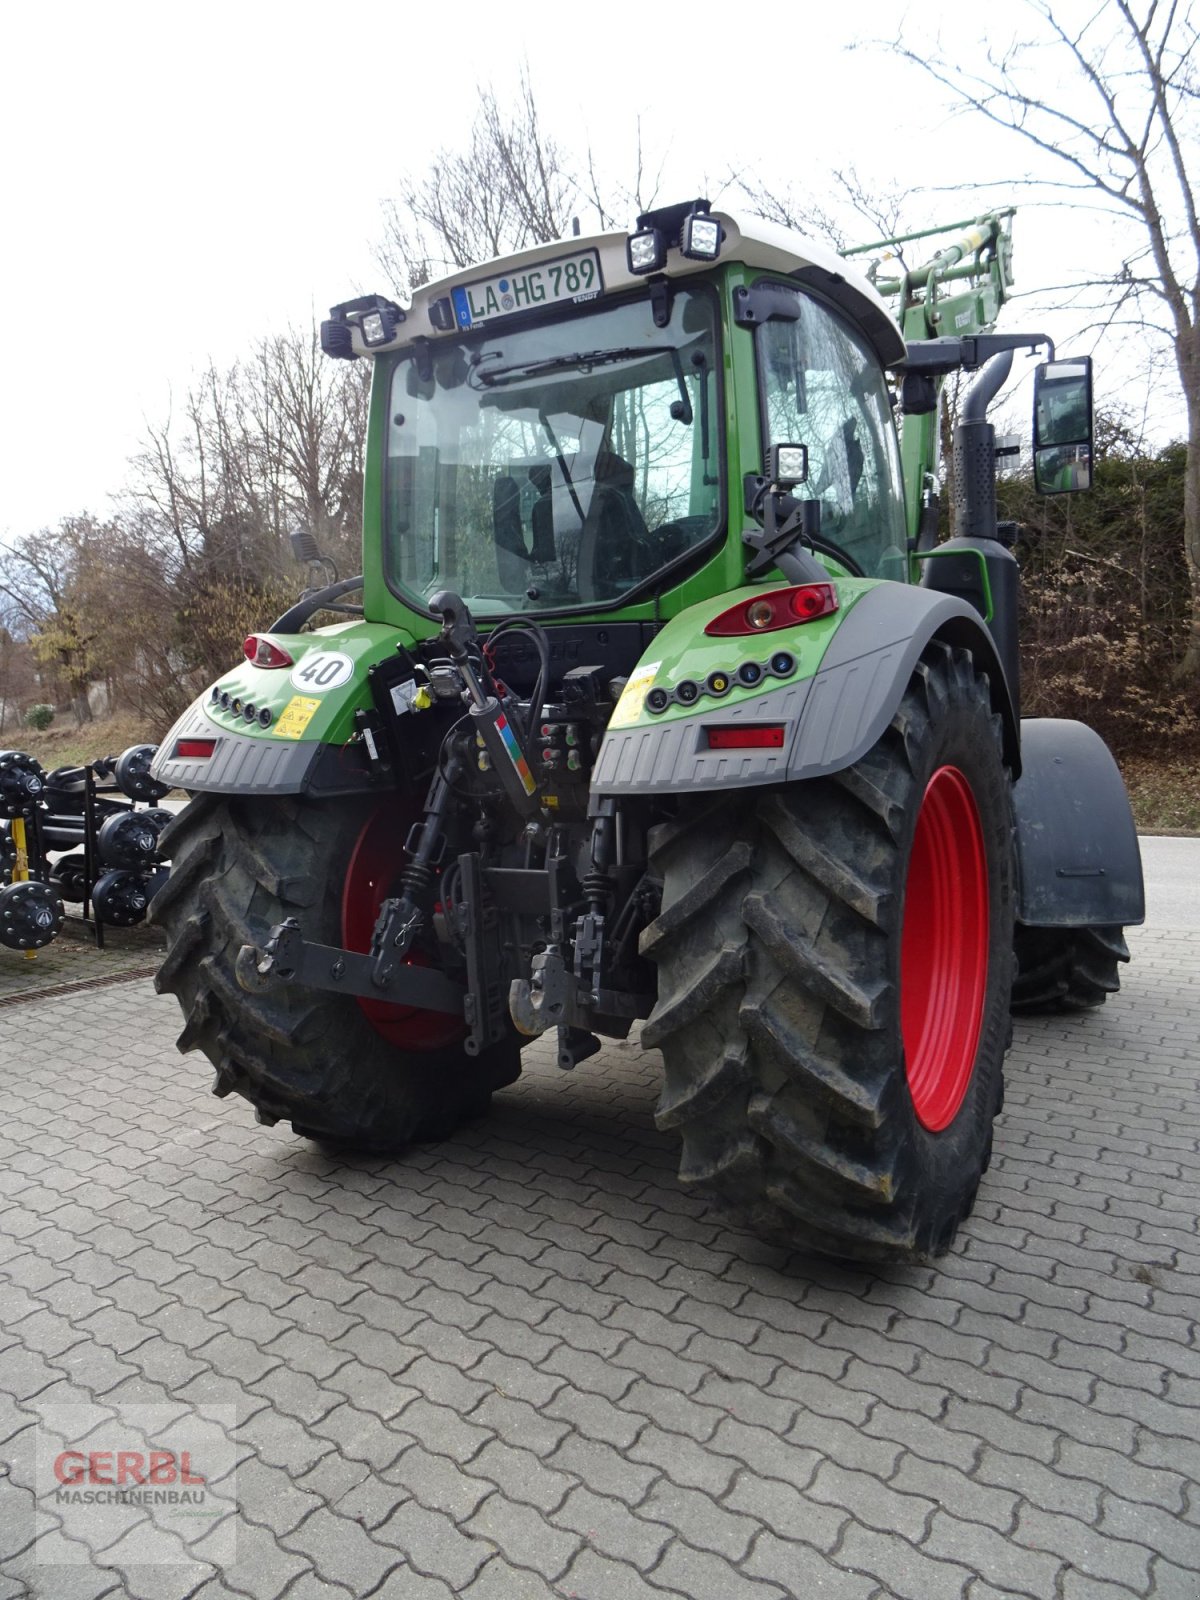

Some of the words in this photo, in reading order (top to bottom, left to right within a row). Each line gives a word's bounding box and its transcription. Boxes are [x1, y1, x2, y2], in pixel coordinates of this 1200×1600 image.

[467, 285, 500, 319] LA
[512, 272, 546, 307] HG
[548, 258, 595, 297] 789
[460, 311, 467, 320] D
[298, 656, 344, 686] 40
